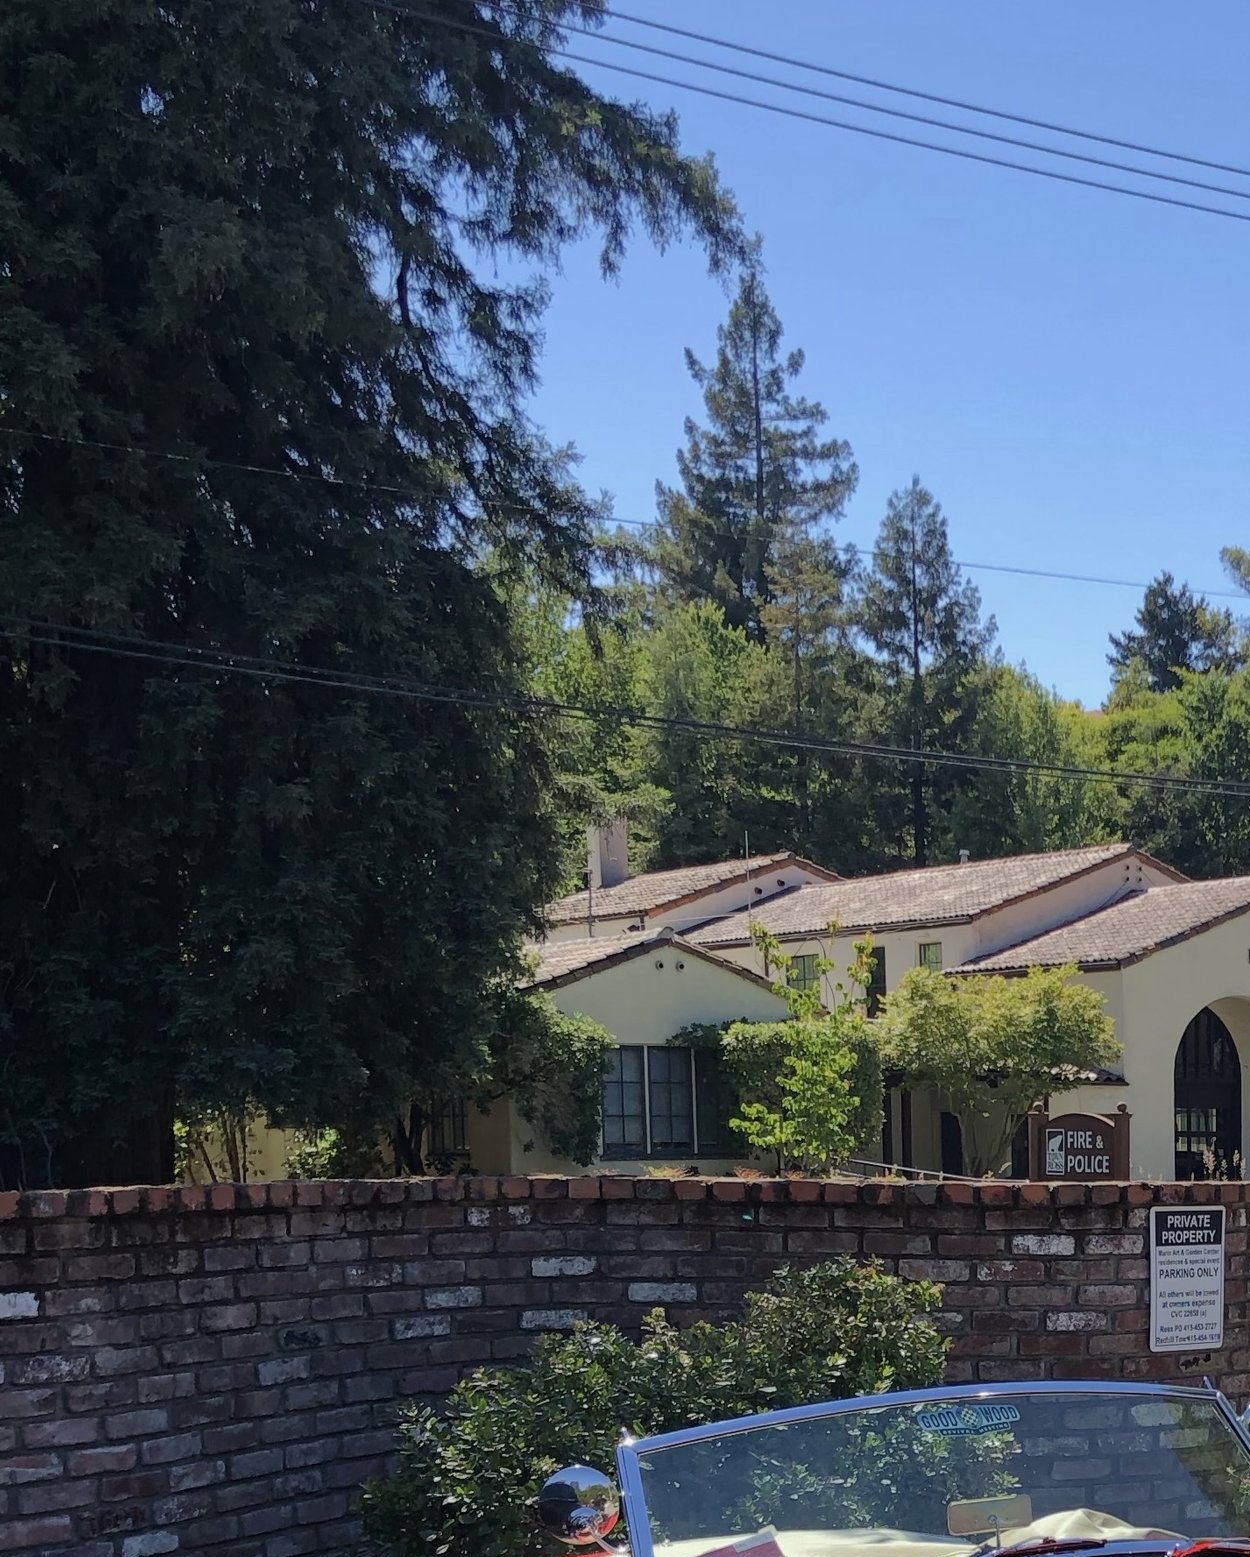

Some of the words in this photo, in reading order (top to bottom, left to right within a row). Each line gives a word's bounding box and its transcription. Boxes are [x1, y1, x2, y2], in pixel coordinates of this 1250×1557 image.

[1067, 1131, 1093, 1149] FIRE
[1095, 1135, 1104, 1149] &
[1067, 1155, 1110, 1173] POLICE
[1167, 1215, 1211, 1228] PRIVATE
[1162, 1230, 1217, 1244] PROPERTY
[1159, 1268, 1195, 1279] PARKING
[1197, 1267, 1219, 1277] ONLY
[1171, 1310, 1183, 1318] CVC
[921, 1411, 958, 1429] GOOD
[980, 1406, 1018, 1422] WOOD
